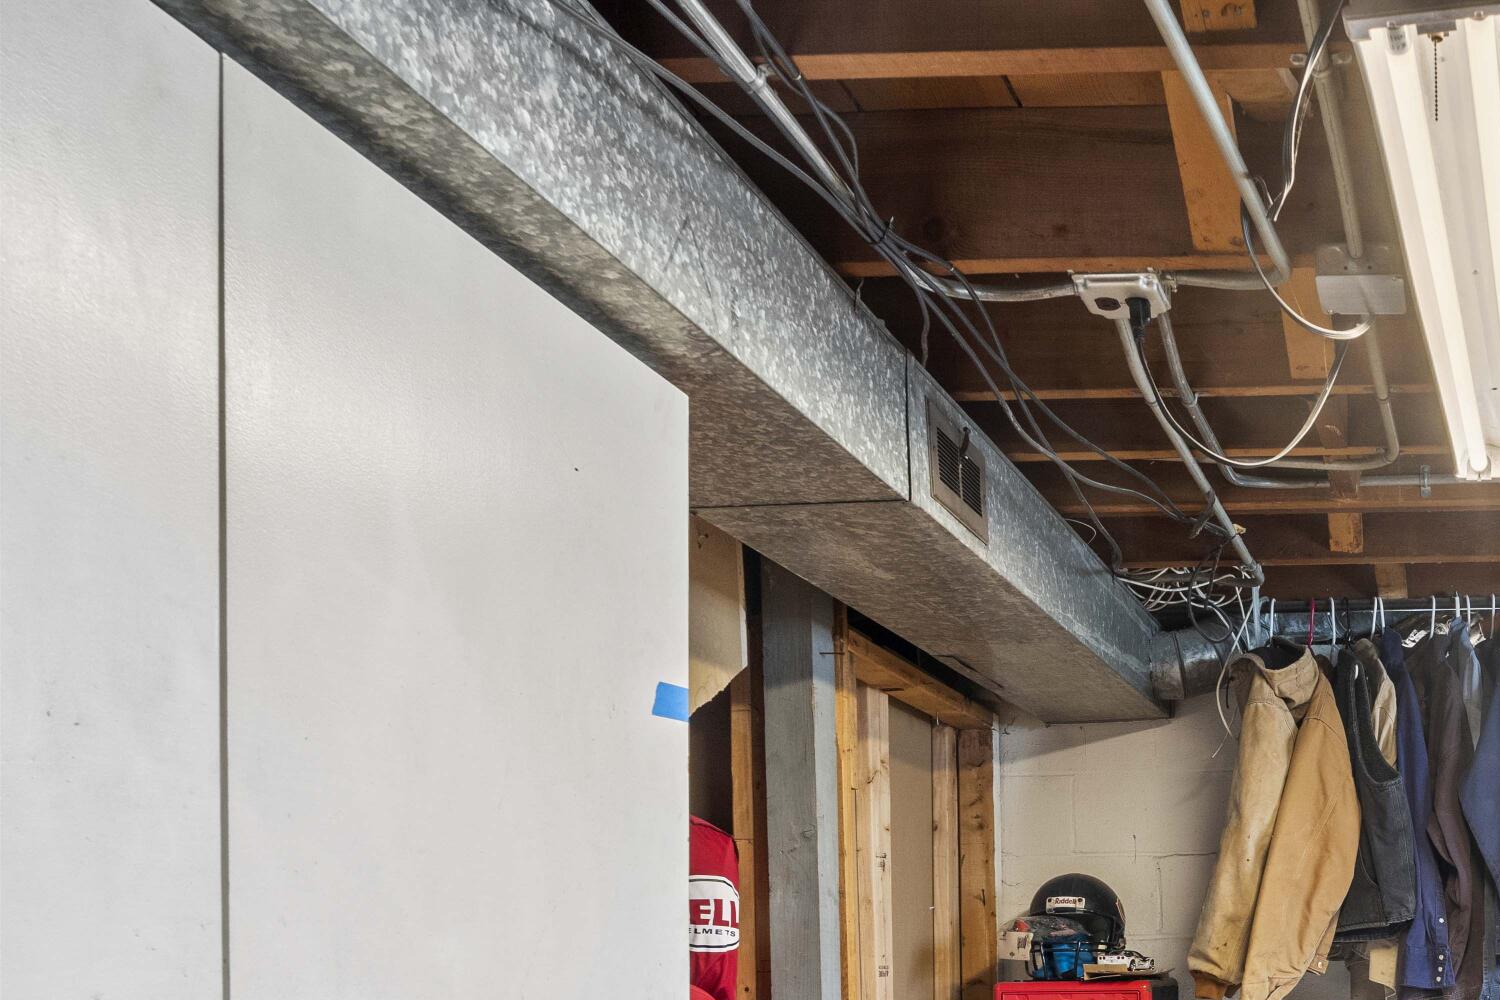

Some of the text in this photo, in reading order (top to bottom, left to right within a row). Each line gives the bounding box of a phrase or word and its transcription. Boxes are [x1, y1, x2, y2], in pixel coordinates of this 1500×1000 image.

[1054, 897, 1077, 905] Riddell
[689, 899, 739, 929] ELL
[689, 928, 736, 937] LMETS
